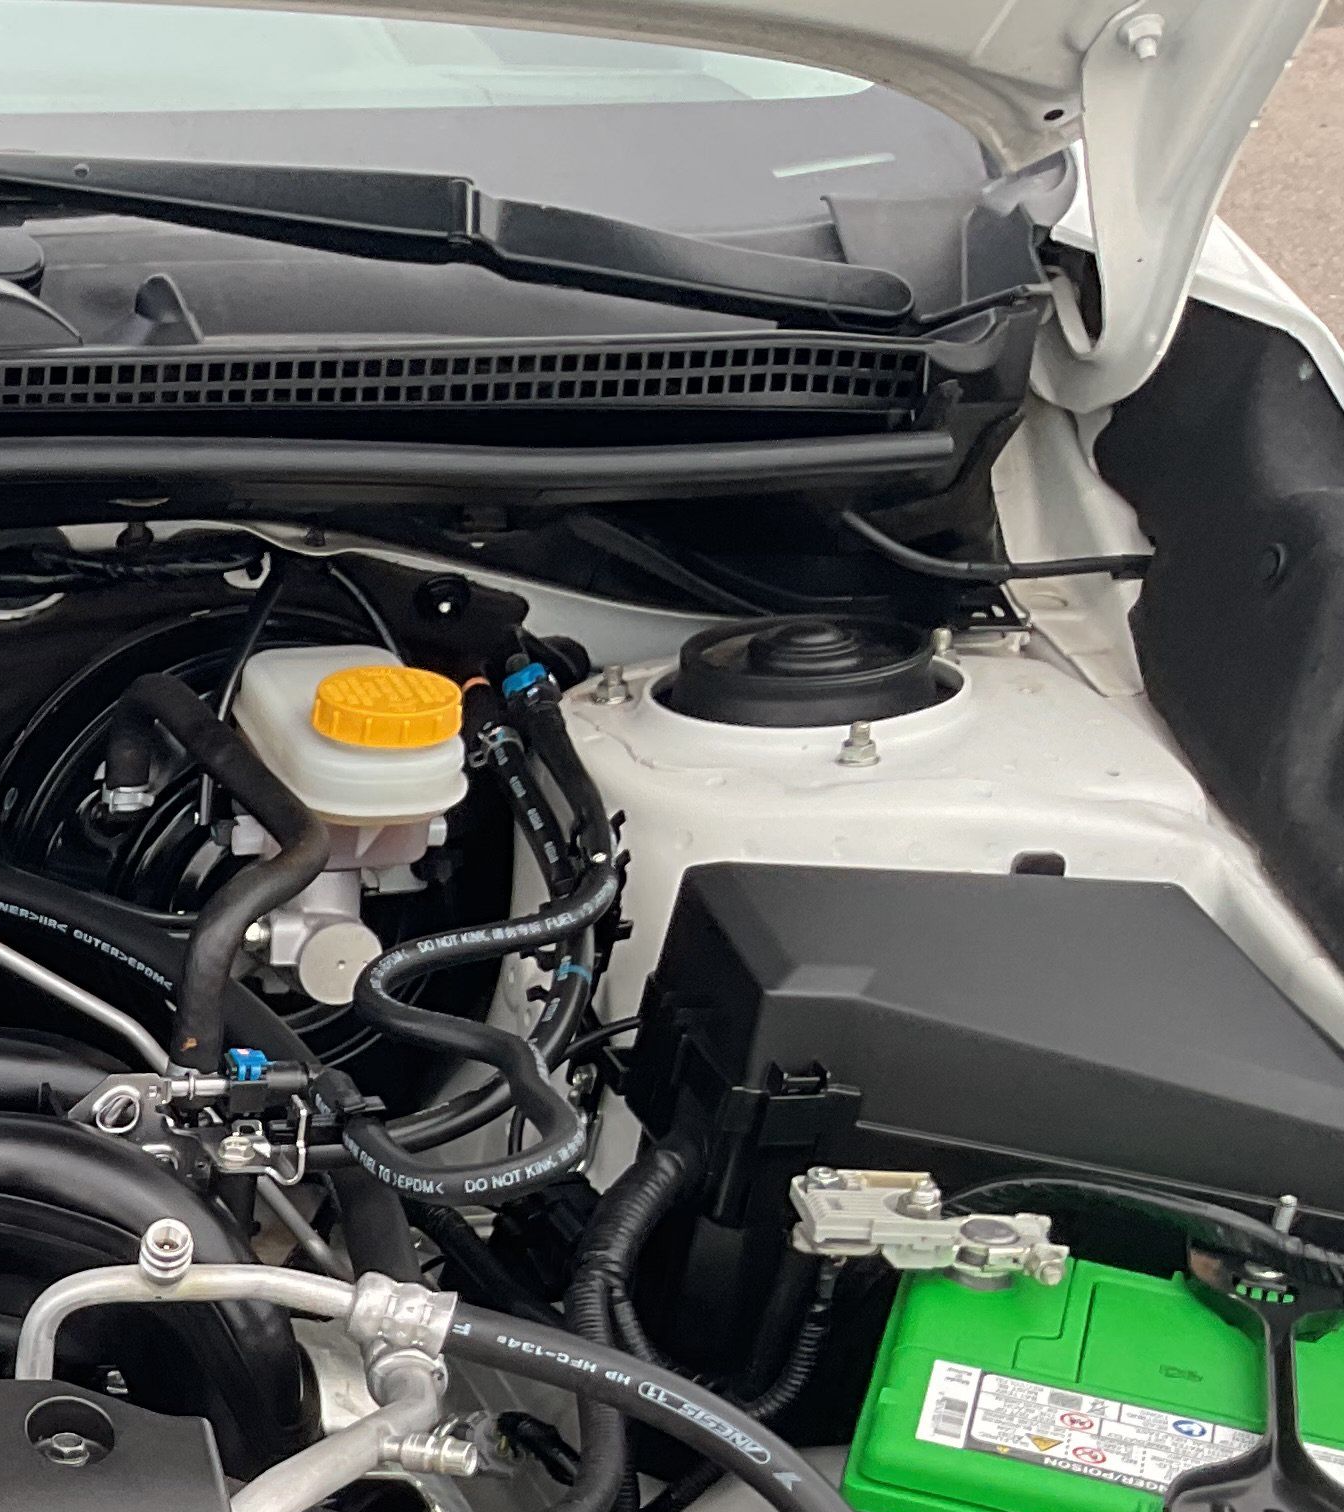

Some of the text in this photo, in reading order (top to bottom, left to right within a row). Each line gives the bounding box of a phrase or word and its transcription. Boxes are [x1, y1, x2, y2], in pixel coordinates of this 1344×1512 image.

[73, 929, 173, 991] OUTER>EPDM<
[465, 1178, 489, 1194] DO
[491, 1169, 521, 1190] NOT
[605, 1369, 631, 1386] HP
